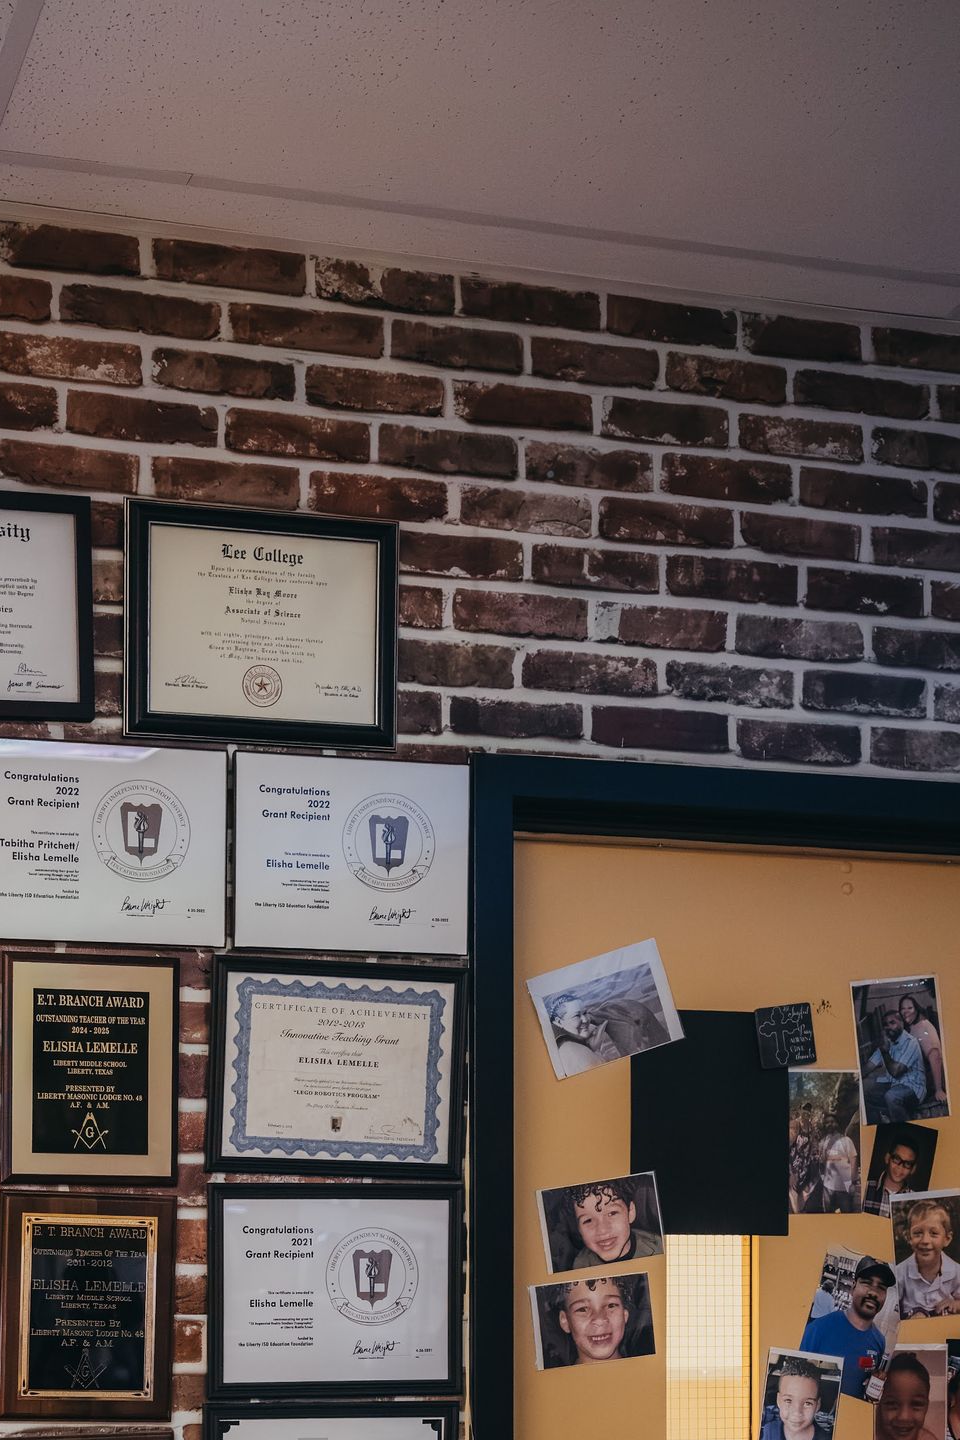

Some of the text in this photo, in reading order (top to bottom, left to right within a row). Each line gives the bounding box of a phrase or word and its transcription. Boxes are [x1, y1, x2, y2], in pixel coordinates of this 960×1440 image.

[221, 544, 303, 567] Lee College
[4, 771, 79, 783] Congratulations
[56, 786, 79, 796] 2022
[259, 784, 330, 796] Congratulations
[7, 796, 79, 809] Grant Recipient
[308, 800, 330, 808] 2022
[262, 809, 330, 822] Grant Recipient
[0, 838, 79, 851] Tabitha Pritchett/
[12, 851, 79, 863] Elisha Lemelle
[266, 859, 330, 870] Elisha Lemelle
[37, 994, 144, 1008] E.T. BRANCH AWARD
[255, 1002, 326, 1013] CERTIFICATE
[350, 1009, 427, 1020] ACHIEVEMENT
[36, 1014, 78, 1023] OUTSTANDING
[79, 1015, 107, 1024] TEACHER
[107, 1016, 116, 1024] OF
[130, 1017, 145, 1025] YEAR
[317, 1019, 365, 1028] 2012-2013
[72, 1026, 87, 1034] 2024
[280, 1029, 399, 1046] Innovative Teaching Grant
[43, 1041, 138, 1054] ELISHA LEMELLE
[299, 1057, 379, 1068] ELISHA LEMELLE
[61, 1226, 104, 1238] BRANCH
[109, 1228, 147, 1240] AWARD
[242, 1225, 314, 1236] Congratulations
[291, 1238, 312, 1246] 2021
[245, 1250, 314, 1260] Grant Recipient
[32, 1279, 145, 1292] ELISHA LEMELLE
[250, 1299, 313, 1308] Elisha Lemelle
